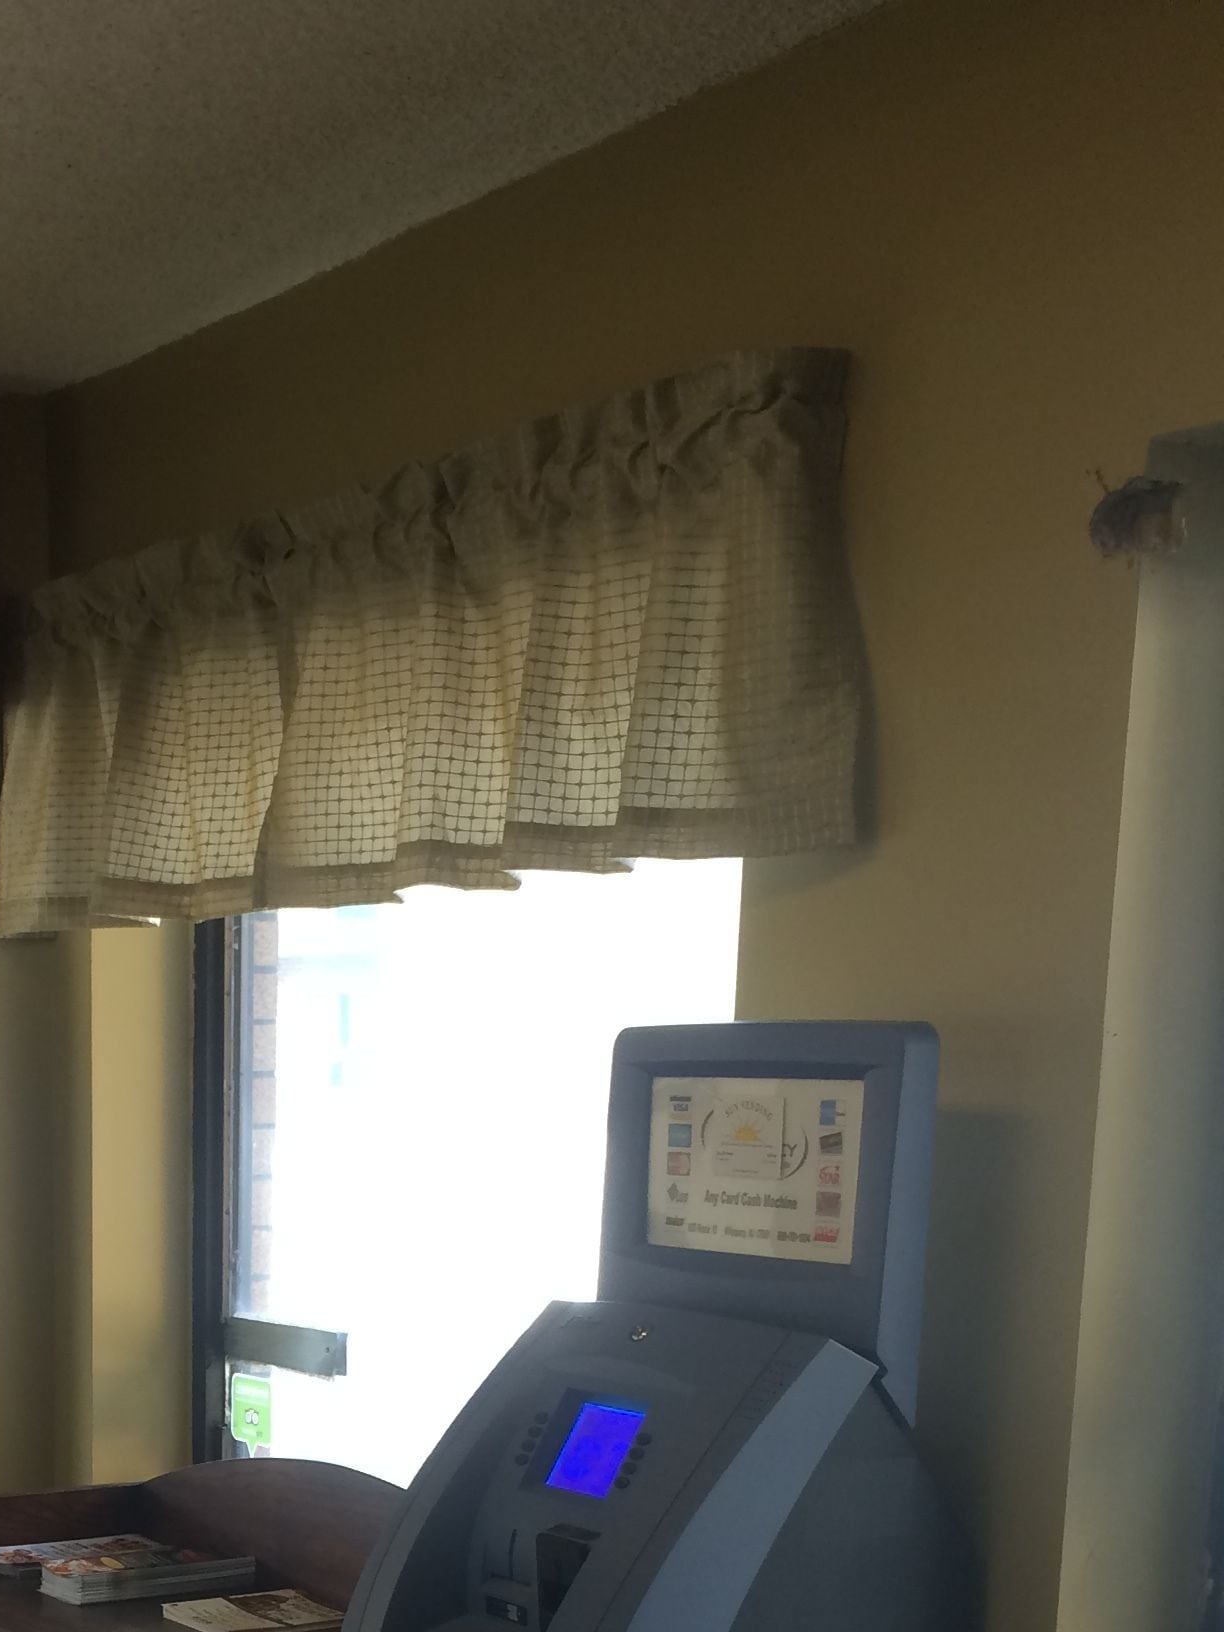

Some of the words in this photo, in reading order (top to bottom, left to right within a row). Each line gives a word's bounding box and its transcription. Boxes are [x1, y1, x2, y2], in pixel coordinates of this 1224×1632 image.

[704, 1189, 719, 1208] Any
[720, 1190, 741, 1206] Card
[741, 1192, 762, 1207] Cash
[763, 1195, 798, 1210] Machine
